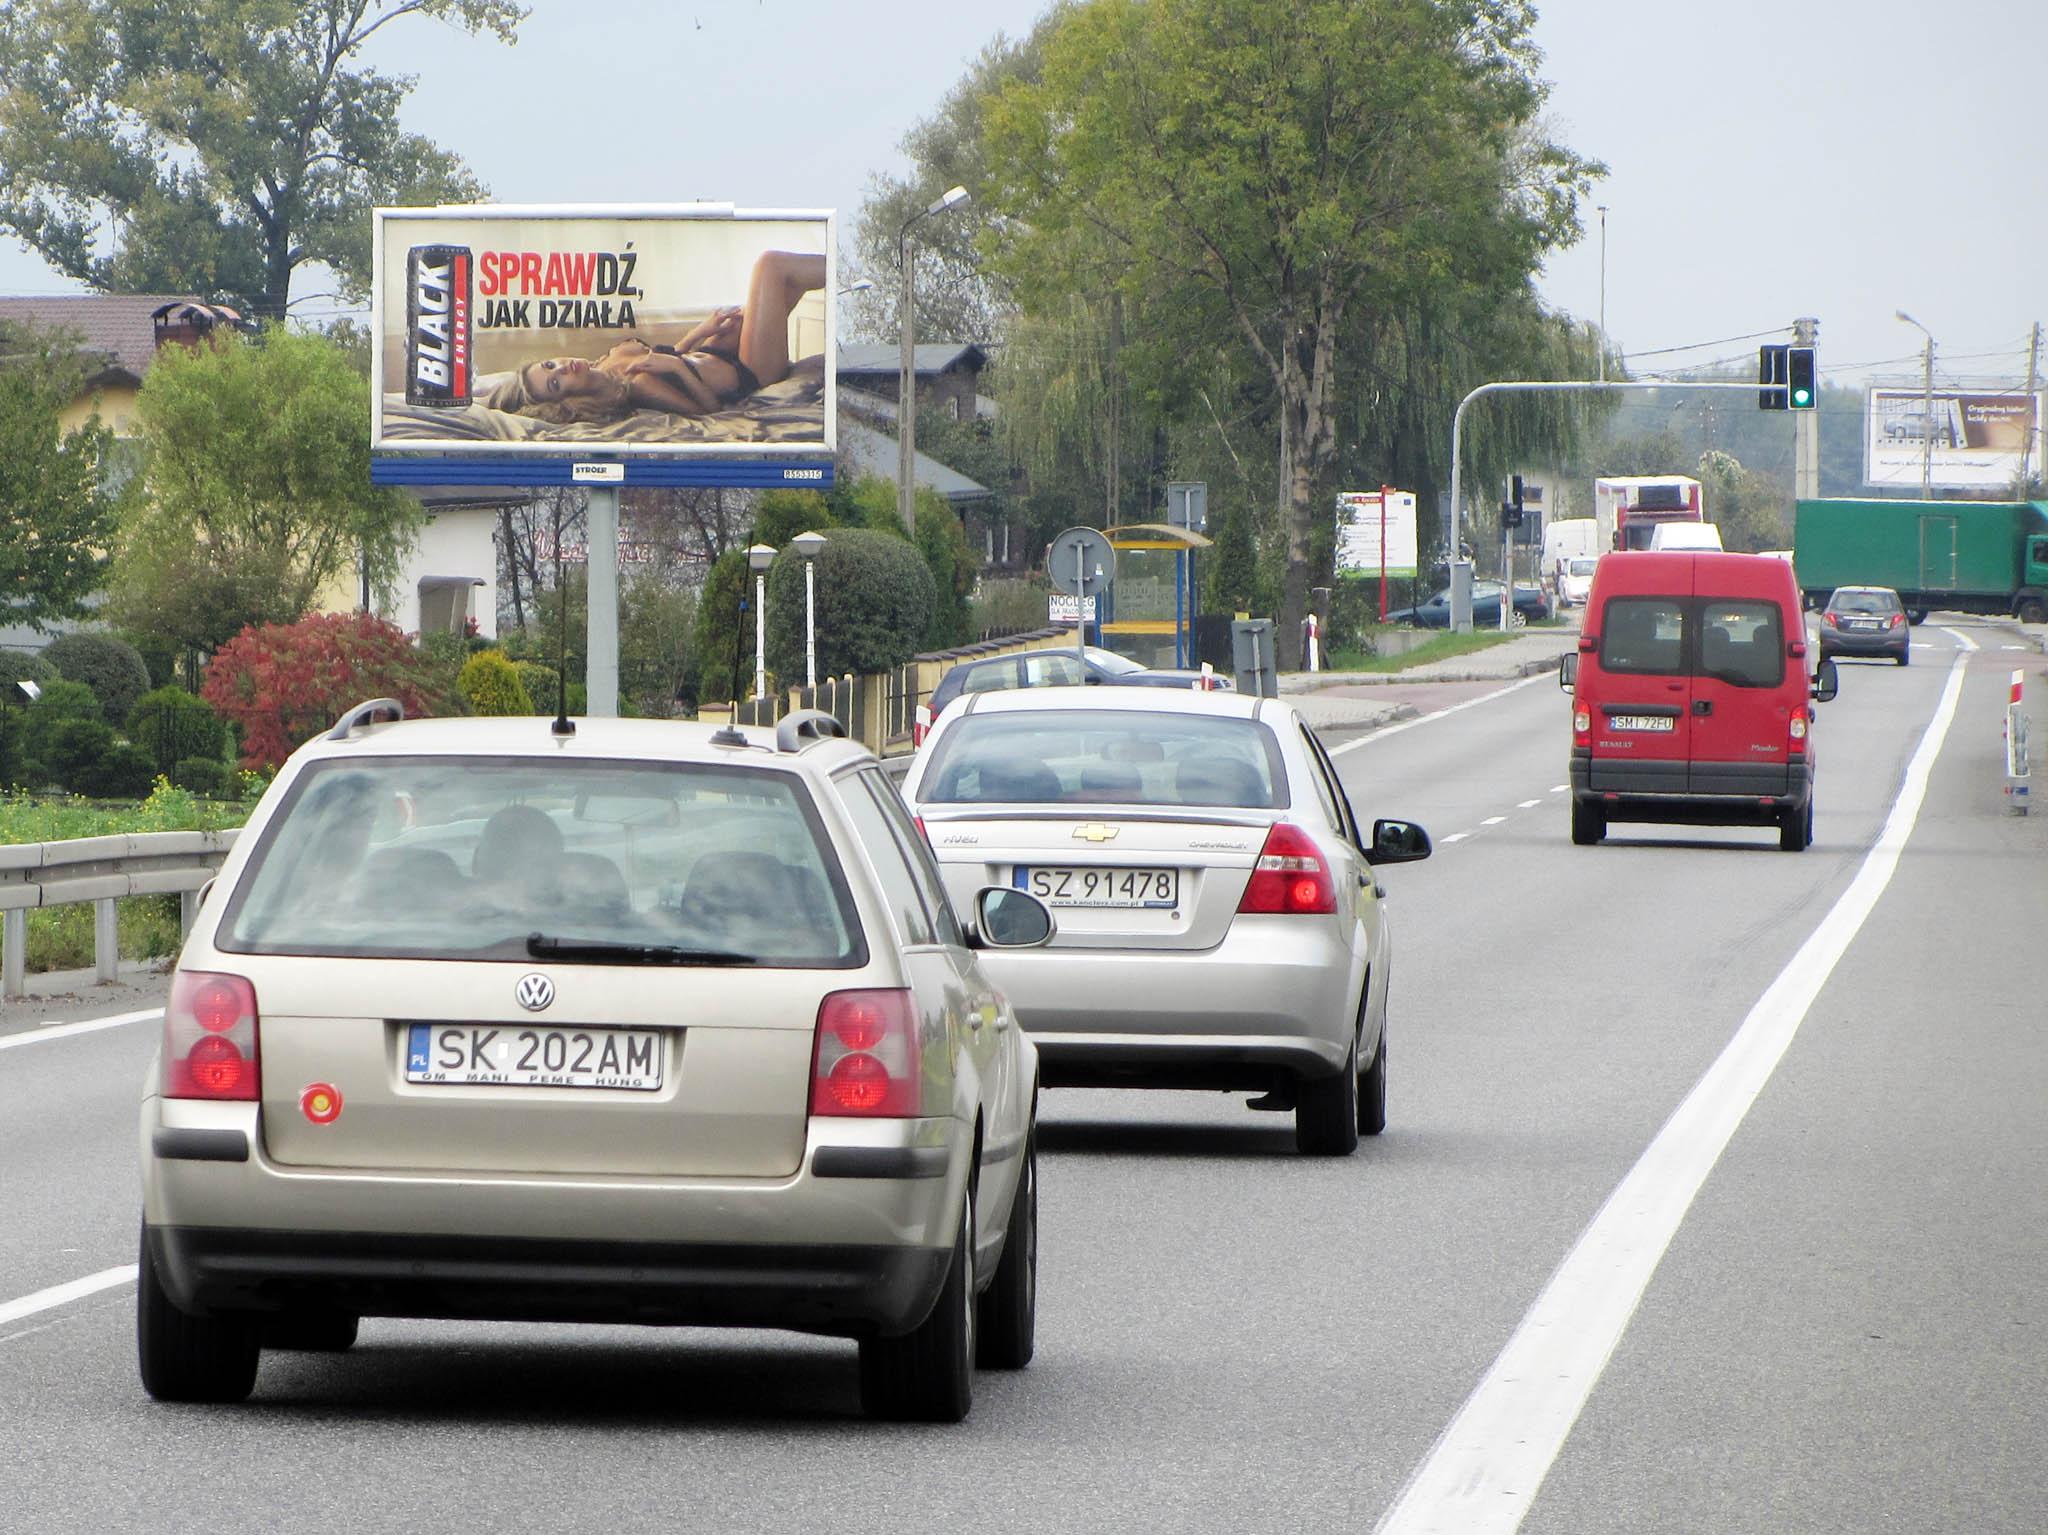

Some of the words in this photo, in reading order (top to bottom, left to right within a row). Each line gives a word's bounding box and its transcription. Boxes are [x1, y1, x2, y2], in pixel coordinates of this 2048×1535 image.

[479, 241, 644, 301] SPRAWDŹ,
[417, 260, 449, 387] BLACK
[477, 300, 531, 328] JAK
[539, 300, 636, 328] DZIAŁA
[456, 297, 465, 364] ENERGY
[1616, 717, 1639, 729] SMI
[1033, 871, 1072, 898] SZ
[1084, 872, 1170, 899] 91478
[411, 1054, 426, 1066] PL
[437, 1030, 499, 1071] SK
[516, 1031, 652, 1076] 202AM
[421, 1073, 446, 1081] OM
[466, 1073, 509, 1083] MANI
